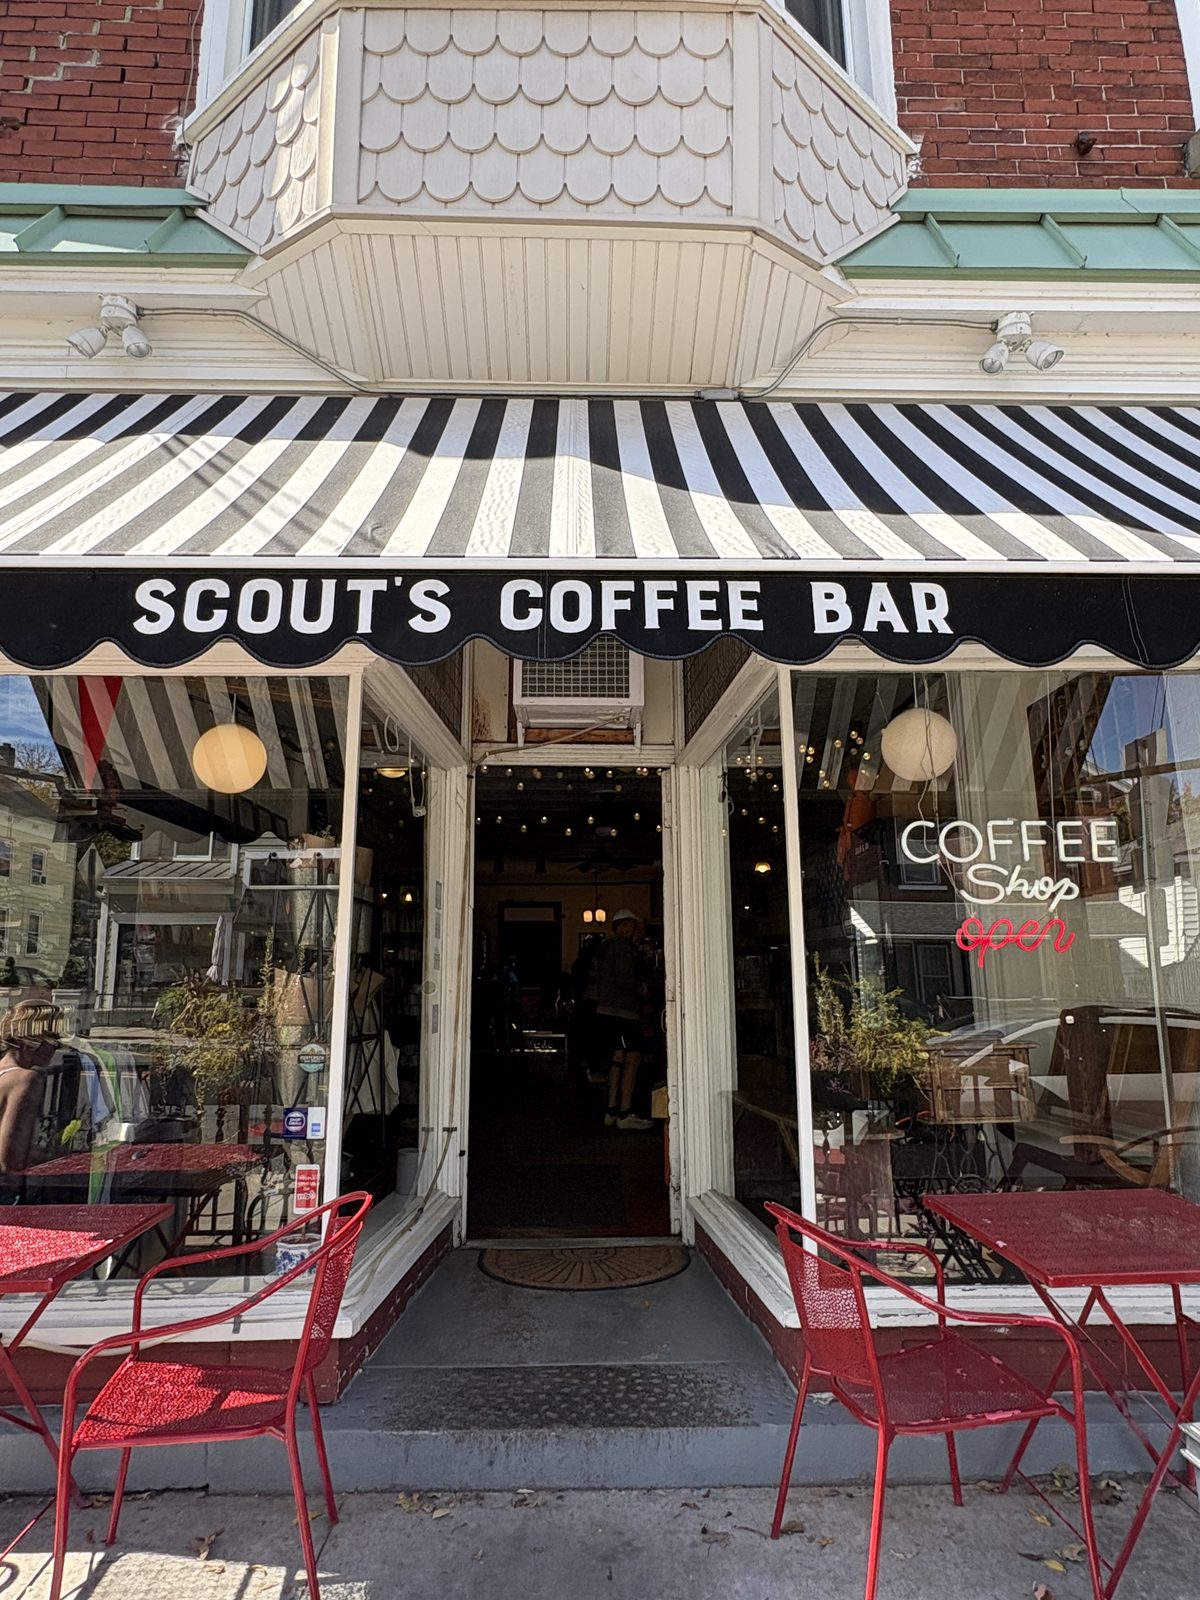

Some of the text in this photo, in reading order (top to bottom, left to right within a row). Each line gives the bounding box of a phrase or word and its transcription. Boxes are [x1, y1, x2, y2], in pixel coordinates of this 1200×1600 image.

[132, 577, 954, 635] SCOUT'S COFFEE BAR
[901, 820, 1119, 864] COFFEE
[959, 863, 1080, 912] Shop
[956, 916, 1075, 968] open
